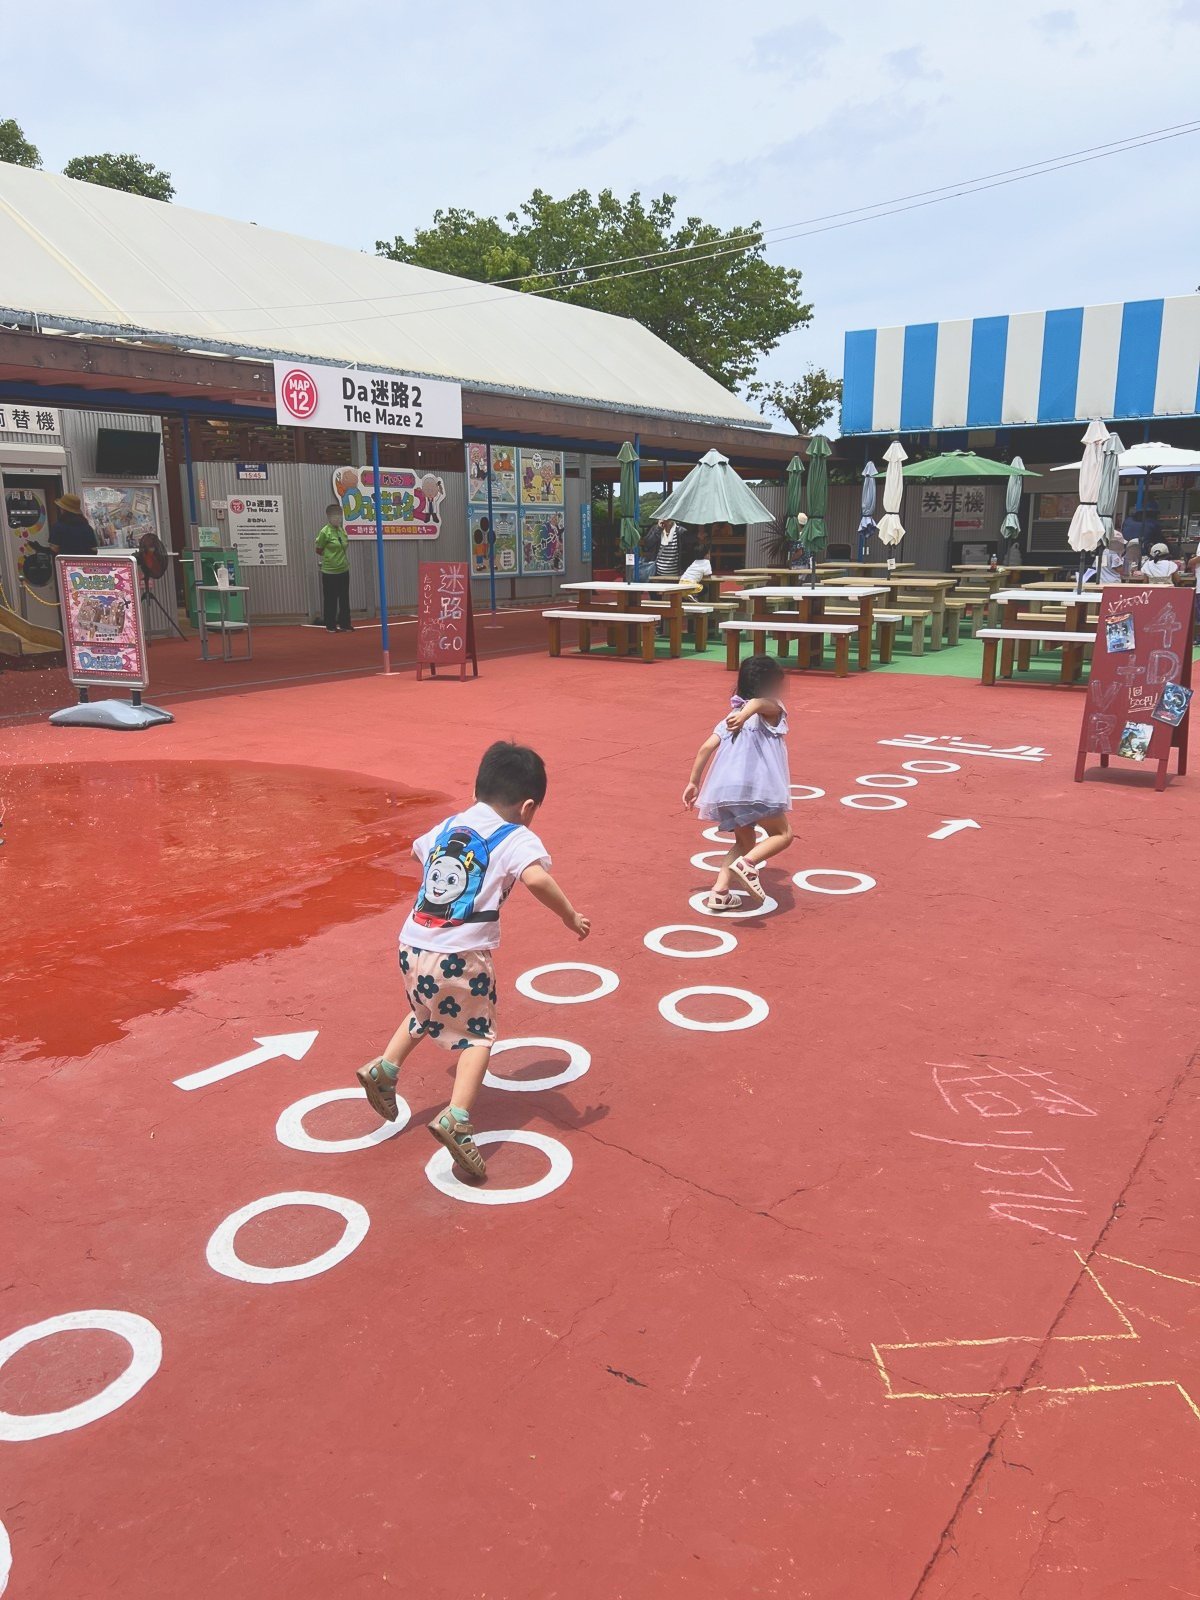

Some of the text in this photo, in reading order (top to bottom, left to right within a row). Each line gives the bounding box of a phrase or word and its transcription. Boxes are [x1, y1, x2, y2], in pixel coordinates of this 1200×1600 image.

[289, 379, 310, 391] MAP
[342, 377, 422, 409] Da迷路2
[290, 391, 310, 411] 12
[343, 405, 423, 428] The Maze 2
[922, 490, 984, 513] 券売機
[439, 636, 463, 651] GO
